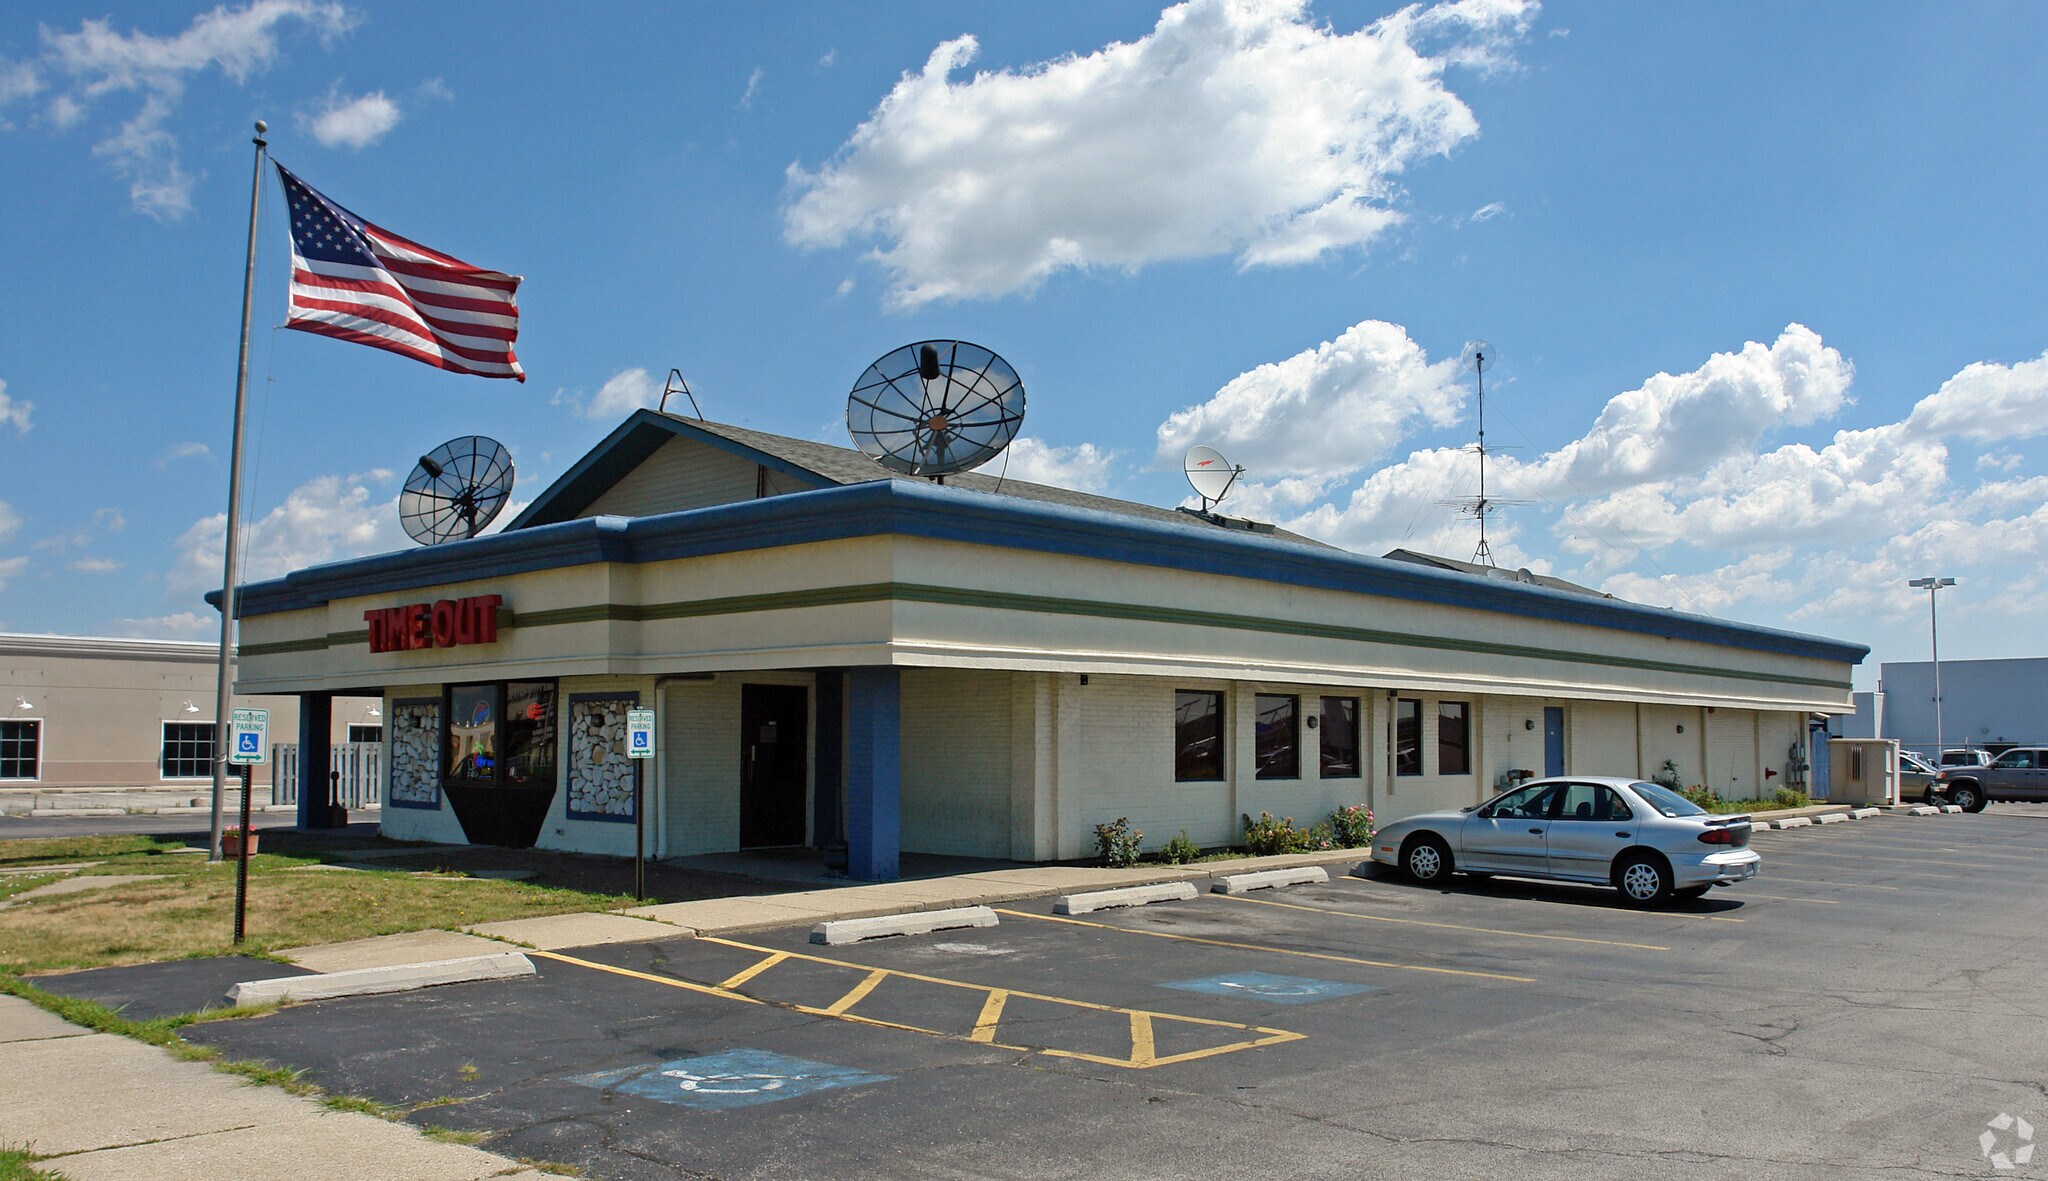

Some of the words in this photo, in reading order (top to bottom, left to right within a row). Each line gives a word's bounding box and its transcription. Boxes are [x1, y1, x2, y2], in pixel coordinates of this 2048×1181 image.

[364, 604, 432, 653] TIME
[432, 594, 502, 647] OUT
[234, 714, 266, 722] RESERVED
[236, 723, 264, 731] PARKING
